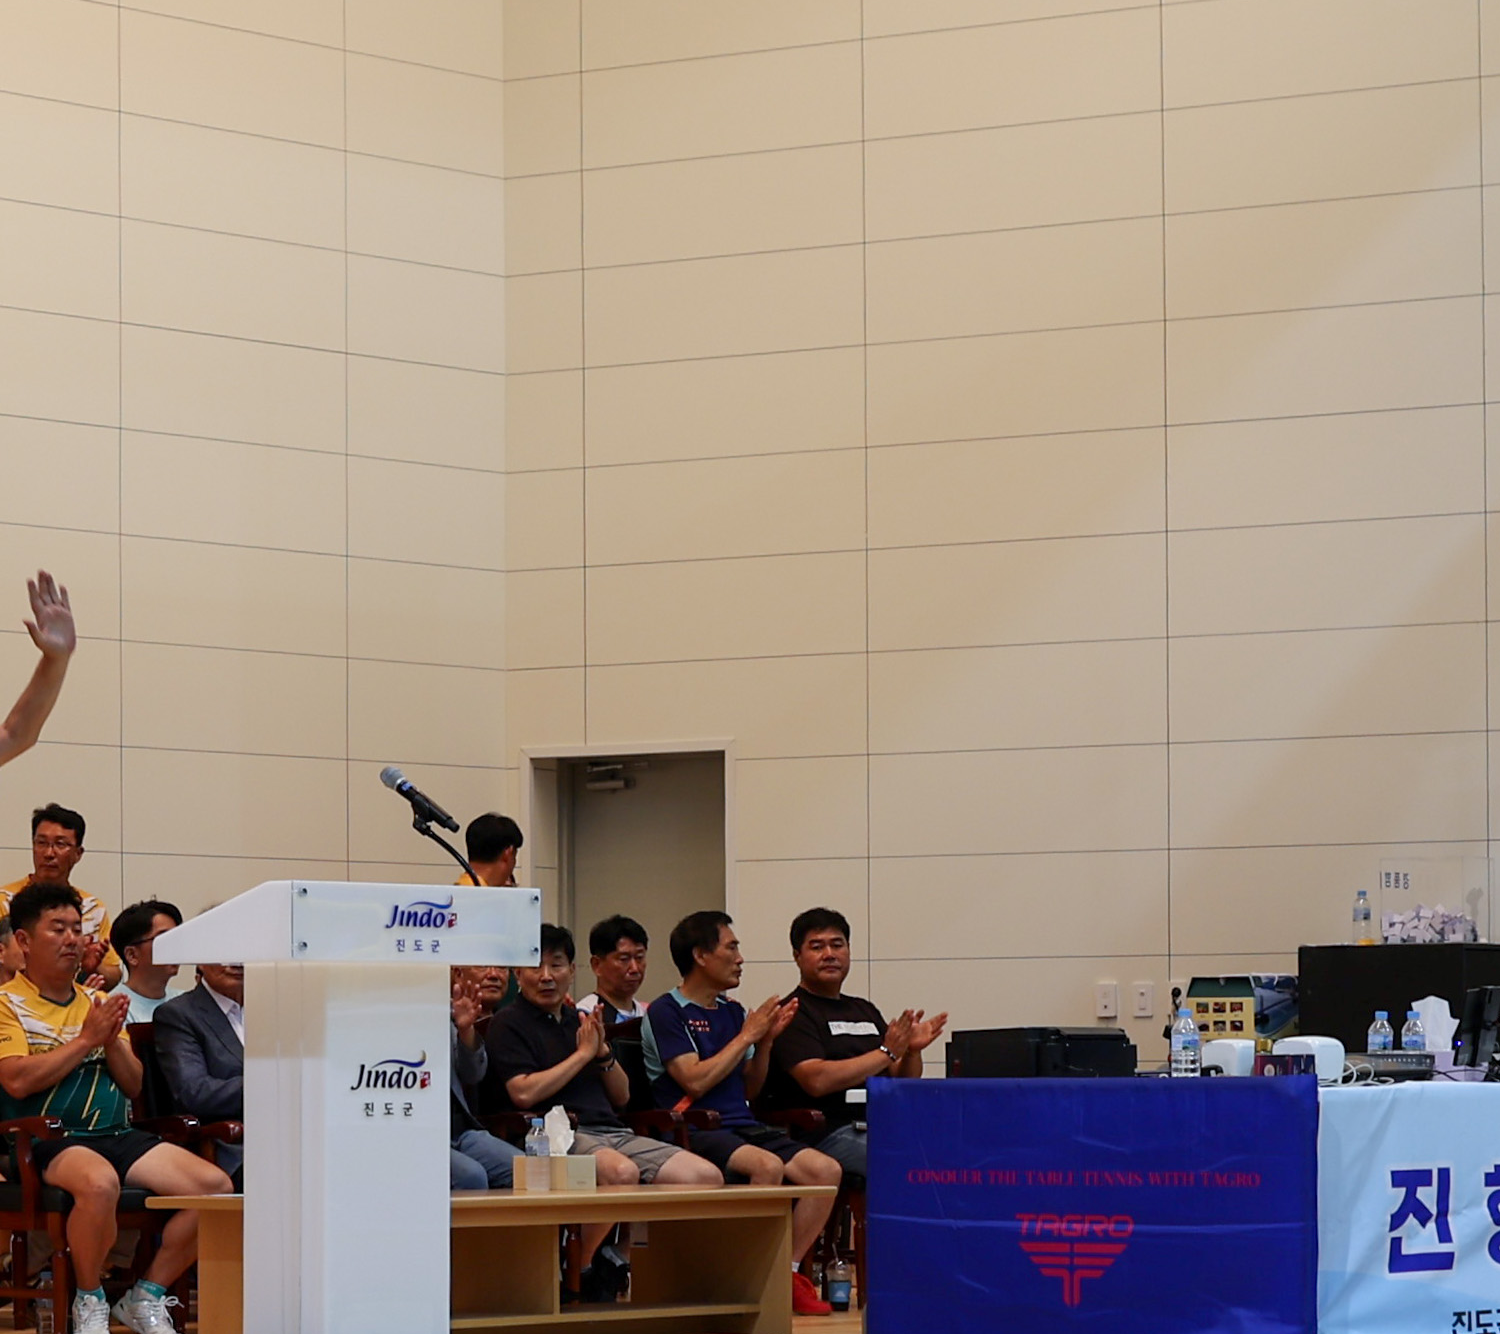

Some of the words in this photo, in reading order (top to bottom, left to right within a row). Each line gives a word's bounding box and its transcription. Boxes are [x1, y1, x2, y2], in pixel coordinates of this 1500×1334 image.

[385, 905, 446, 929] Jindo
[396, 939, 440, 953] 진도군
[350, 1064, 418, 1091] Jindo
[364, 1102, 413, 1117] 진도군
[1015, 1212, 1135, 1240] TAGRO
